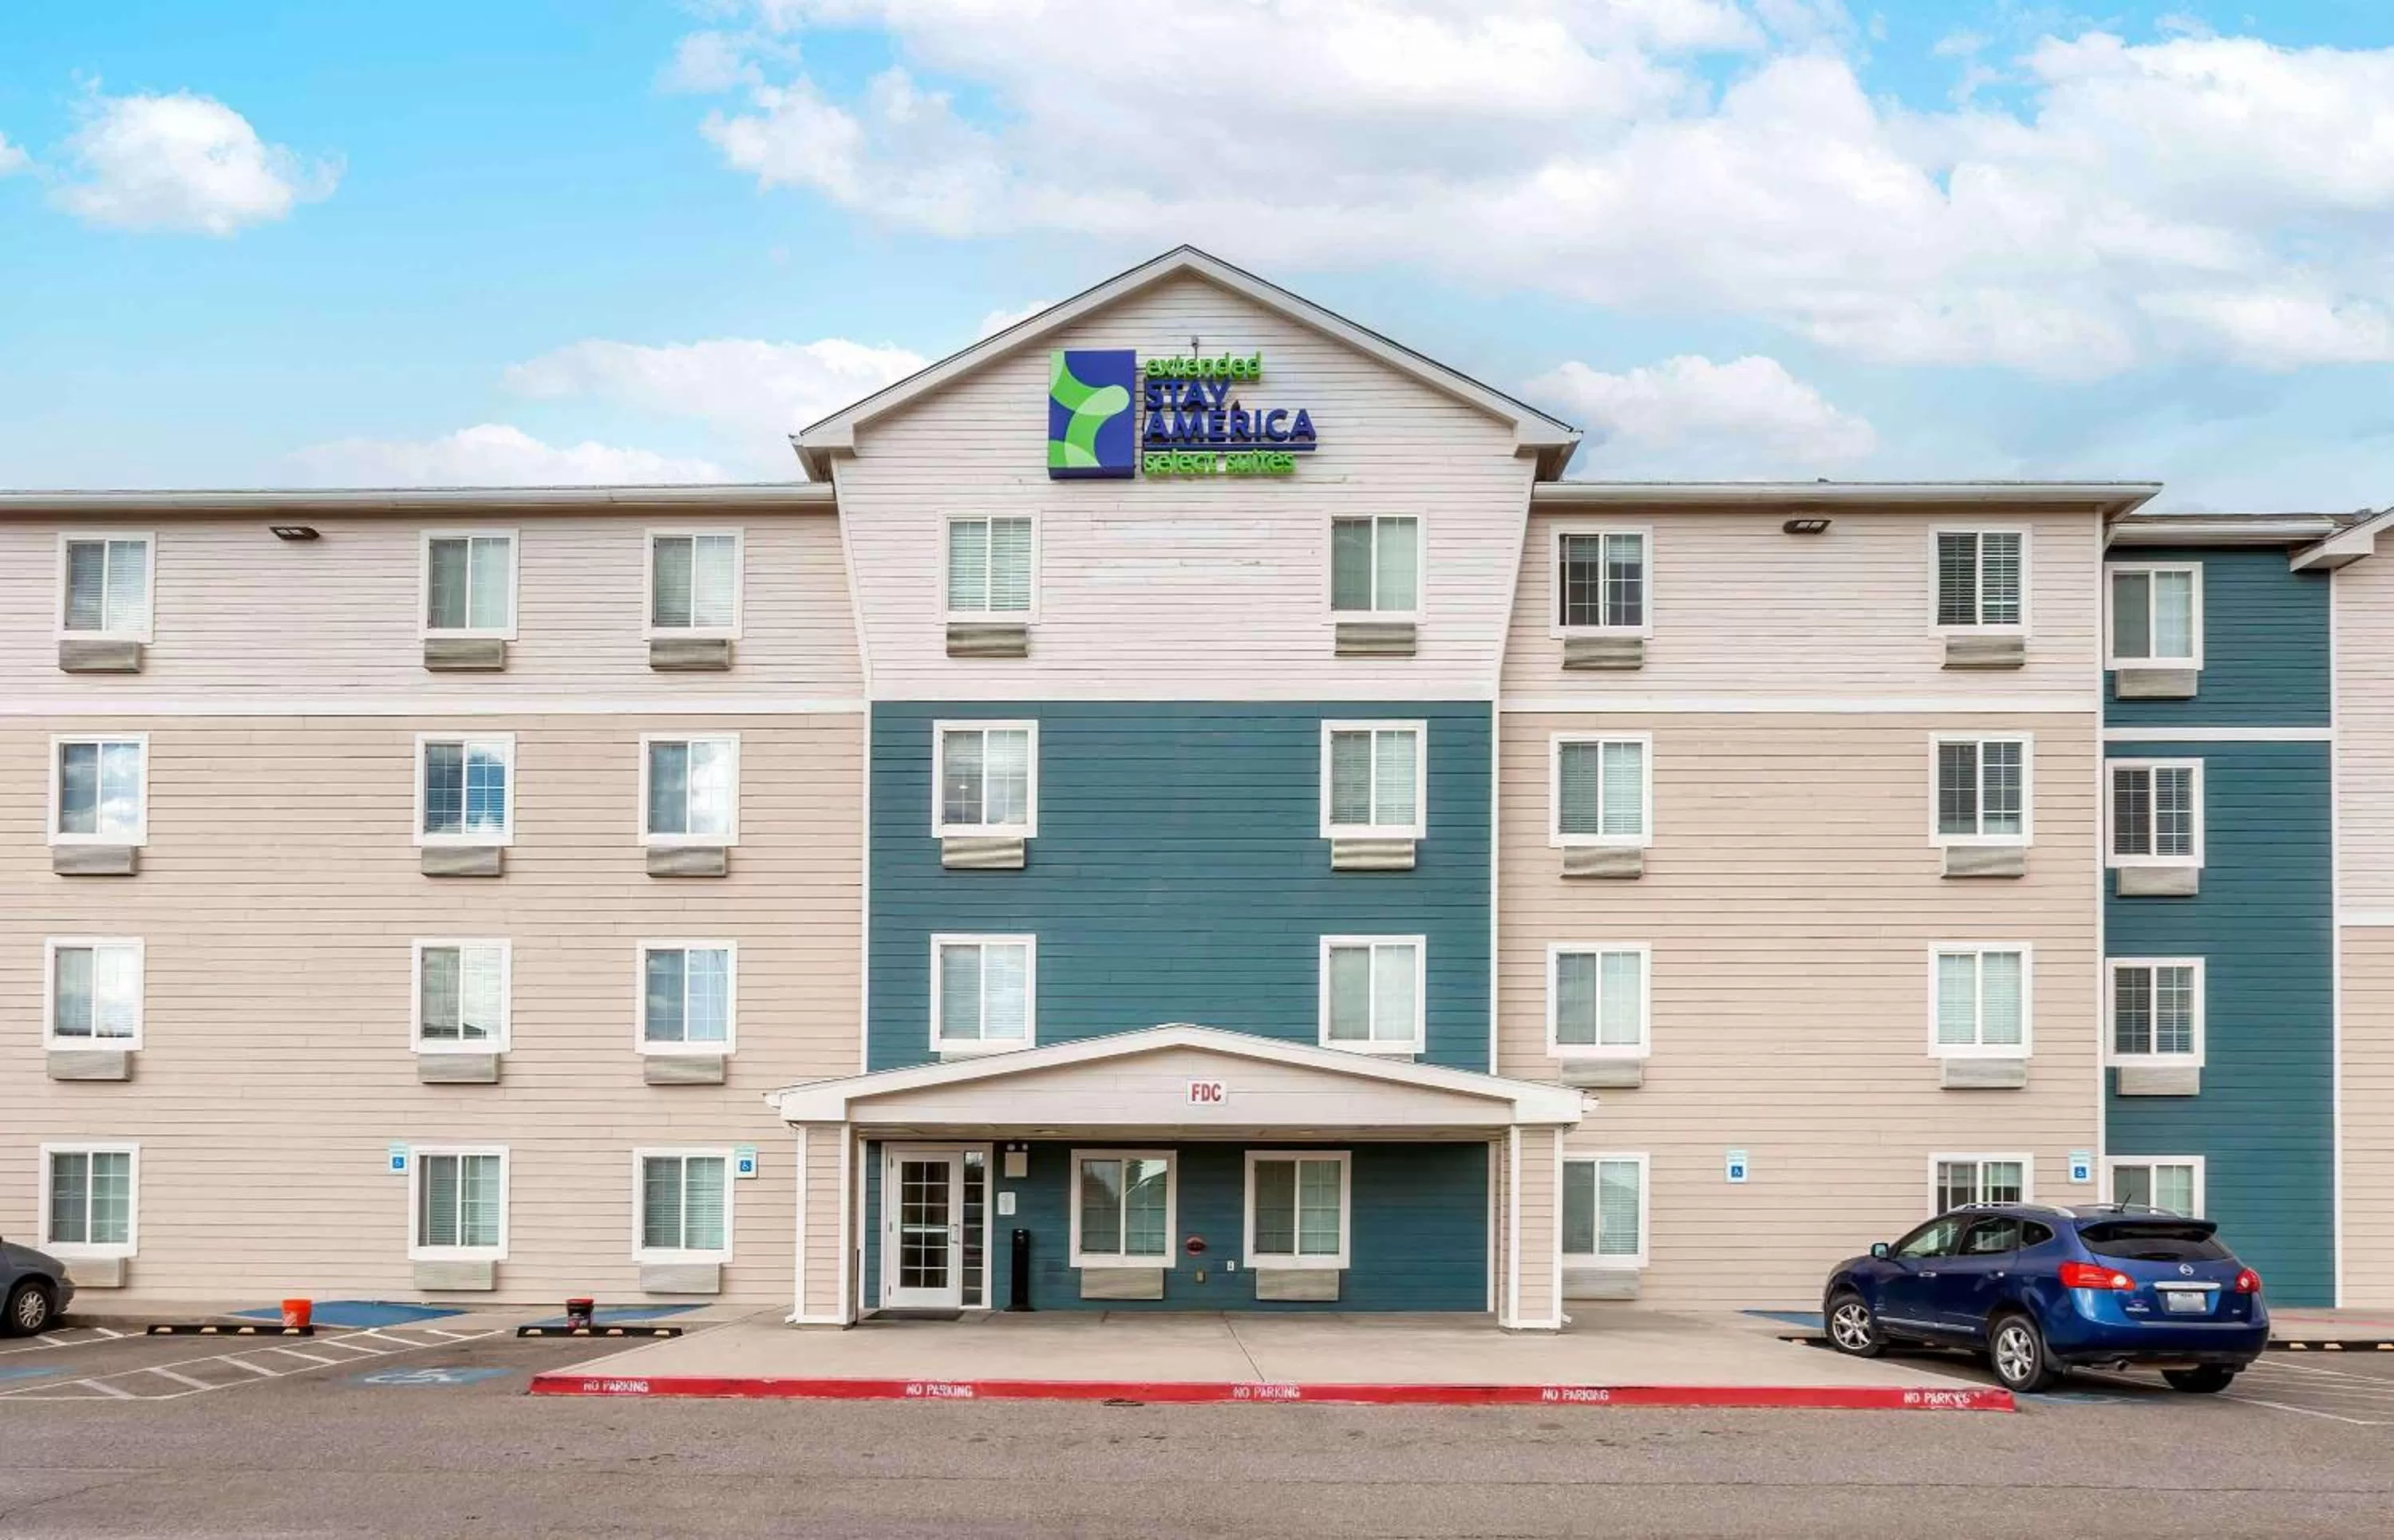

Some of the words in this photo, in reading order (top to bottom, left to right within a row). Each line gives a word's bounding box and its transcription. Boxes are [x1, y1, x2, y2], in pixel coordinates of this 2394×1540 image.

[1145, 351, 1262, 379] extended
[1146, 379, 1231, 411] STAY
[1144, 408, 1317, 442] AMERICA
[1144, 448, 1216, 473] select
[1226, 448, 1296, 473] suites
[1191, 1083, 1222, 1102] FDC
[583, 1379, 599, 1392] NO
[602, 1380, 649, 1392] PARKING
[906, 1383, 922, 1396] NO
[926, 1384, 973, 1397] PARKING
[1233, 1385, 1250, 1399] NO
[1254, 1385, 1300, 1399] PARKING
[1542, 1388, 1558, 1401] NO
[1562, 1388, 1610, 1401] PARKING
[1903, 1392, 1920, 1404] NO
